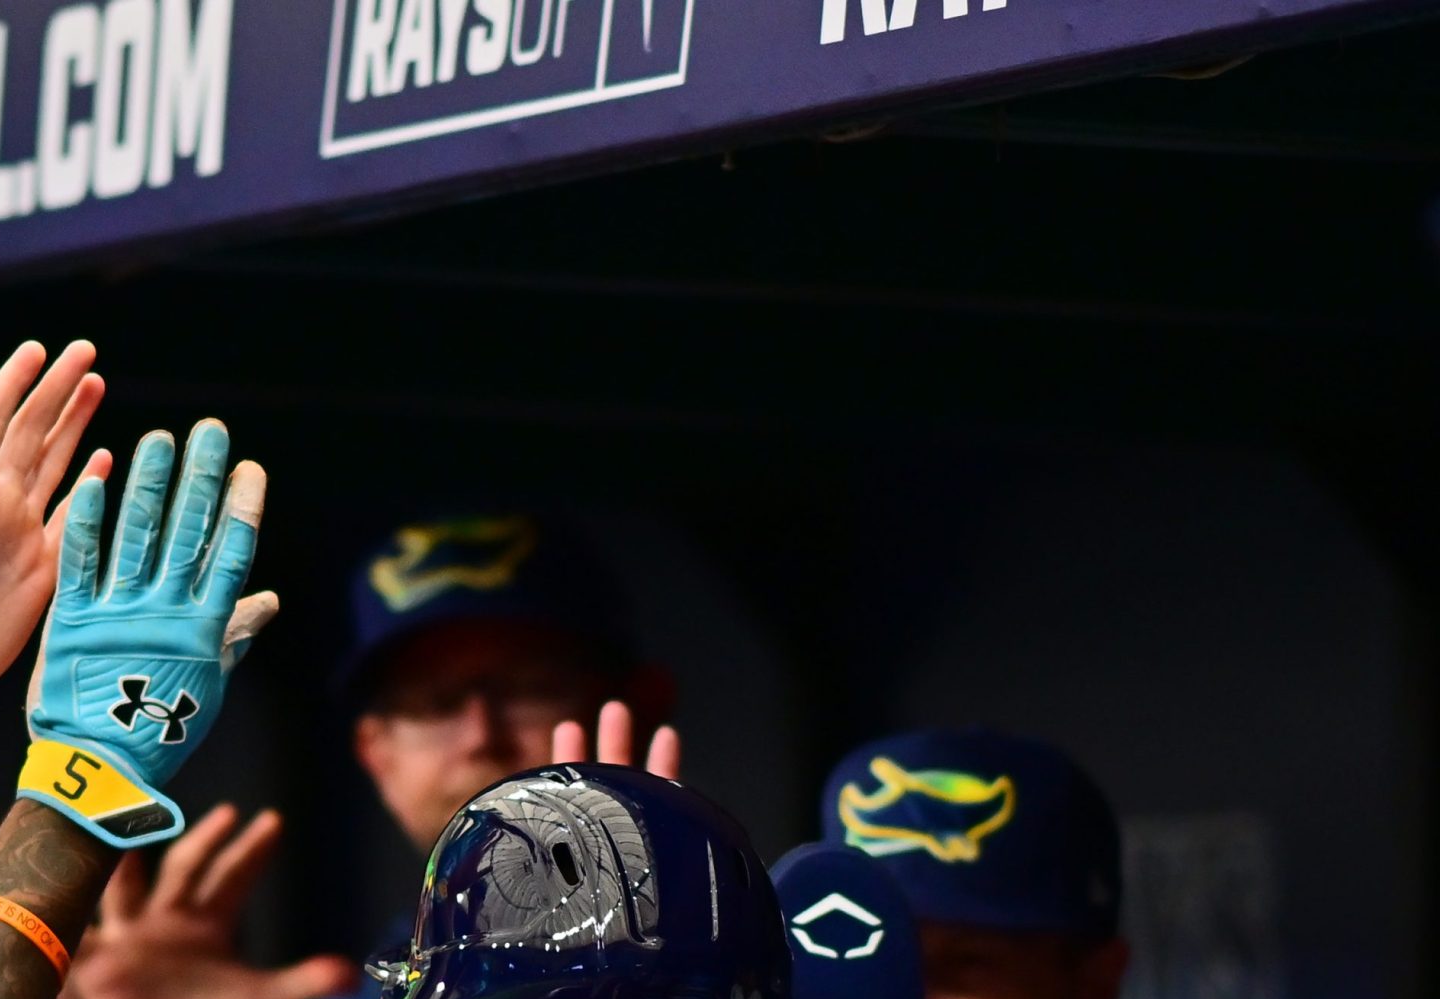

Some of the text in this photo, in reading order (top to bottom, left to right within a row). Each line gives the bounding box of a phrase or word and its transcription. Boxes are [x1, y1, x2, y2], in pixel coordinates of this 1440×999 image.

[53, 751, 102, 800] 5
[4, 905, 17, 918] IS
[17, 912, 41, 934] NOT
